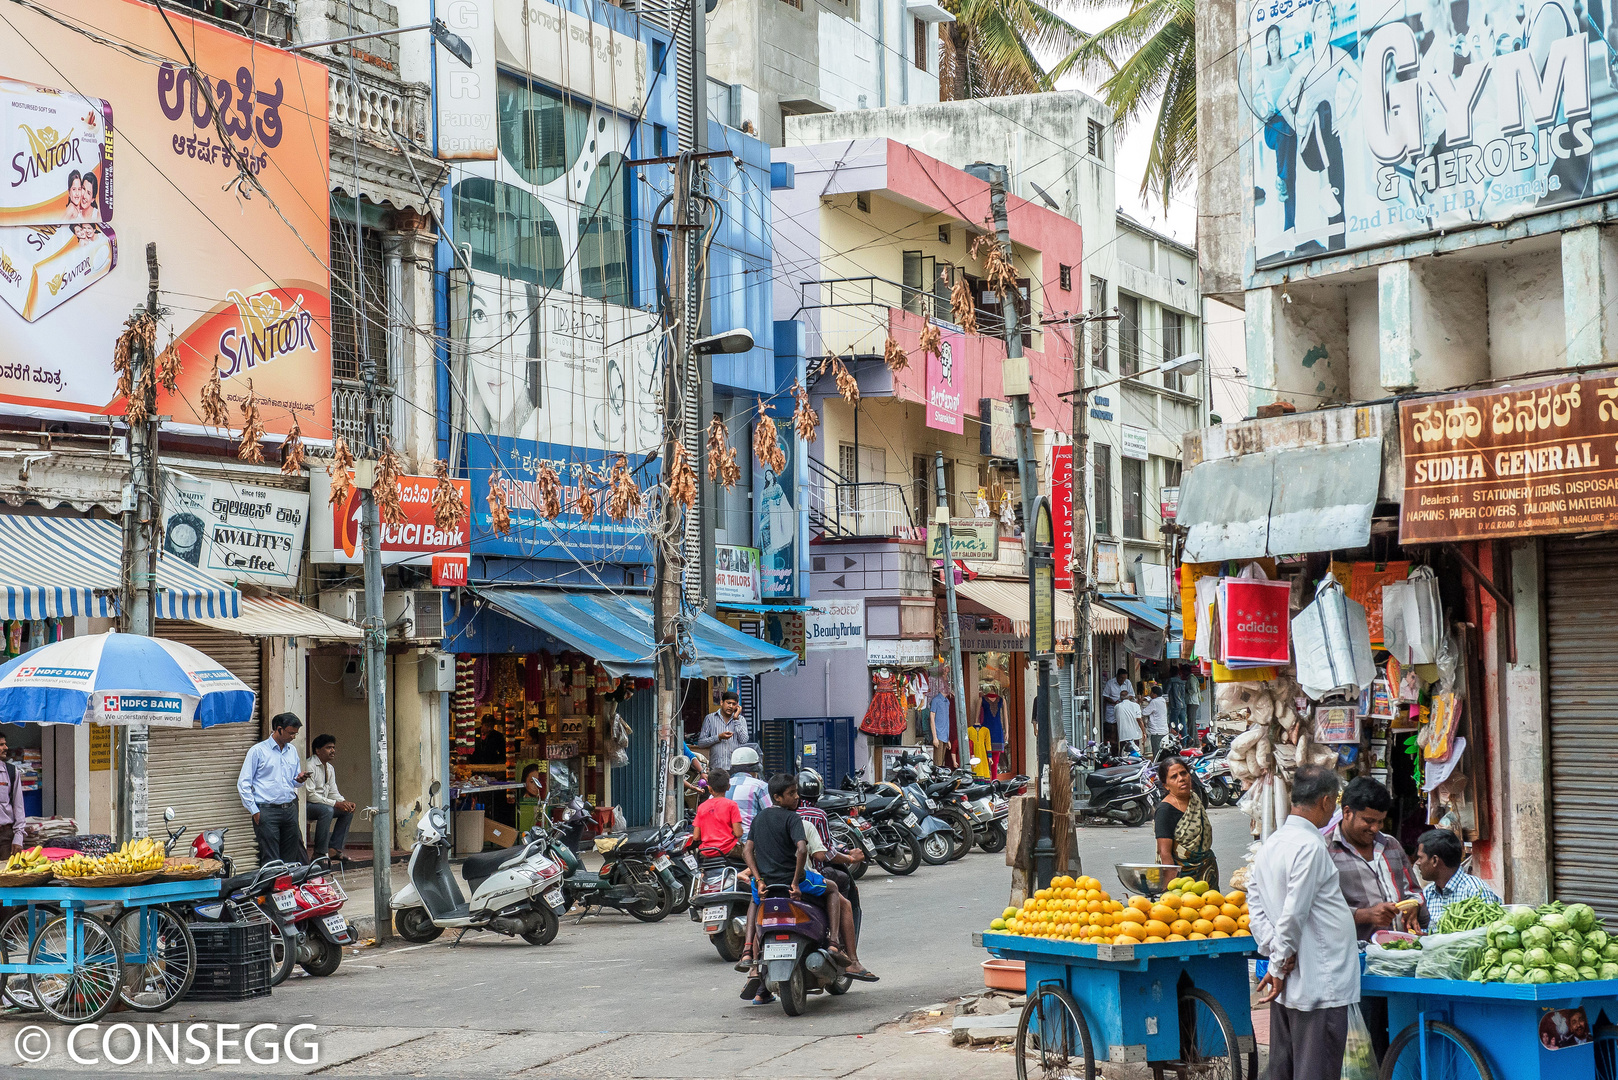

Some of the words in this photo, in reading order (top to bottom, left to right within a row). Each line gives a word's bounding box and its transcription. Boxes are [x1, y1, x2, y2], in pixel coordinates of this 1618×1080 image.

[1362, 21, 1592, 164] GYM
[158, 61, 284, 148] ಉಚಿತ
[441, 110, 491, 130] Fancy
[438, 135, 494, 151] Centre
[11, 138, 83, 188] SANTOOR
[1414, 118, 1594, 197] AEROBICS
[1349, 211, 1382, 233] 2nd
[1490, 173, 1561, 203] Samaja
[219, 311, 316, 379] SANTOOR
[1414, 454, 1487, 484] SUDHA
[1494, 441, 1600, 477] GENERAL
[241, 488, 254, 498] Since
[255, 491, 266, 499] 1950
[1472, 486, 1534, 502] STATIONERY
[1449, 507, 1477, 520] PAPER
[1523, 499, 1567, 515] TAILORING
[1563, 514, 1605, 525] BANGALORE
[422, 523, 464, 547] Bank
[441, 562, 464, 580] ATM
[727, 574, 751, 588] TAILORS
[812, 622, 840, 640] Beauty
[840, 622, 863, 636] Parlour
[1237, 621, 1279, 634] adidas
[977, 640, 1000, 649] FAMILY
[1002, 640, 1024, 649] STORE
[63, 669, 92, 677] BANK
[121, 698, 148, 708] HDFC
[150, 699, 180, 710] BANK
[117, 713, 148, 721] understand
